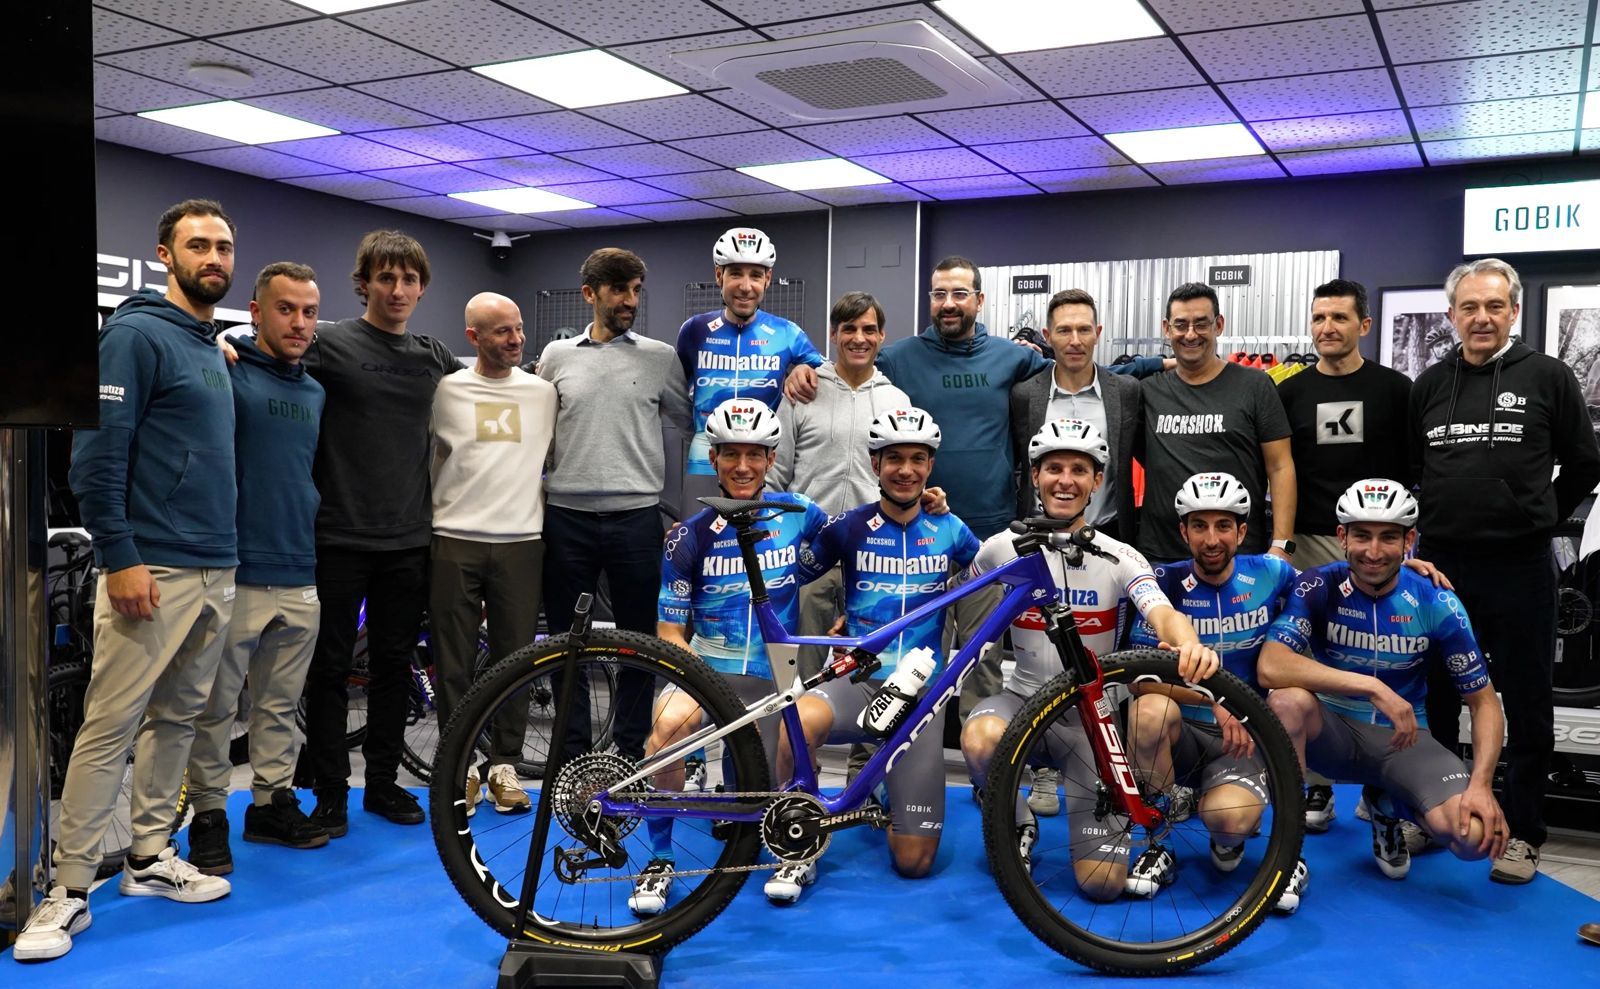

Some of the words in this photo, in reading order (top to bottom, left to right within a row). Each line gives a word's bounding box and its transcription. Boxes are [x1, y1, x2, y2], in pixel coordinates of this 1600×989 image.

[1495, 204, 1580, 231] GOBIK
[1215, 269, 1243, 282] GOBIK
[1017, 278, 1043, 290] GOBIK
[697, 350, 780, 371] Klimatiza
[696, 376, 778, 388] ORBEA
[942, 373, 990, 389] GOBIK
[268, 398, 315, 424] GOBIK
[713, 538, 740, 549] ROCKSHO
[866, 536, 896, 547] ROCKSHOX
[856, 550, 948, 575] Klimatiza
[702, 574, 796, 594] OREA
[856, 580, 945, 595] ORBEA
[1390, 615, 1412, 623] GOBIK
[1326, 620, 1430, 655] Klimatiza
[1031, 684, 1080, 729] PIRELL
[906, 803, 932, 814] GOBIK
[1082, 827, 1108, 836] GOBIK
